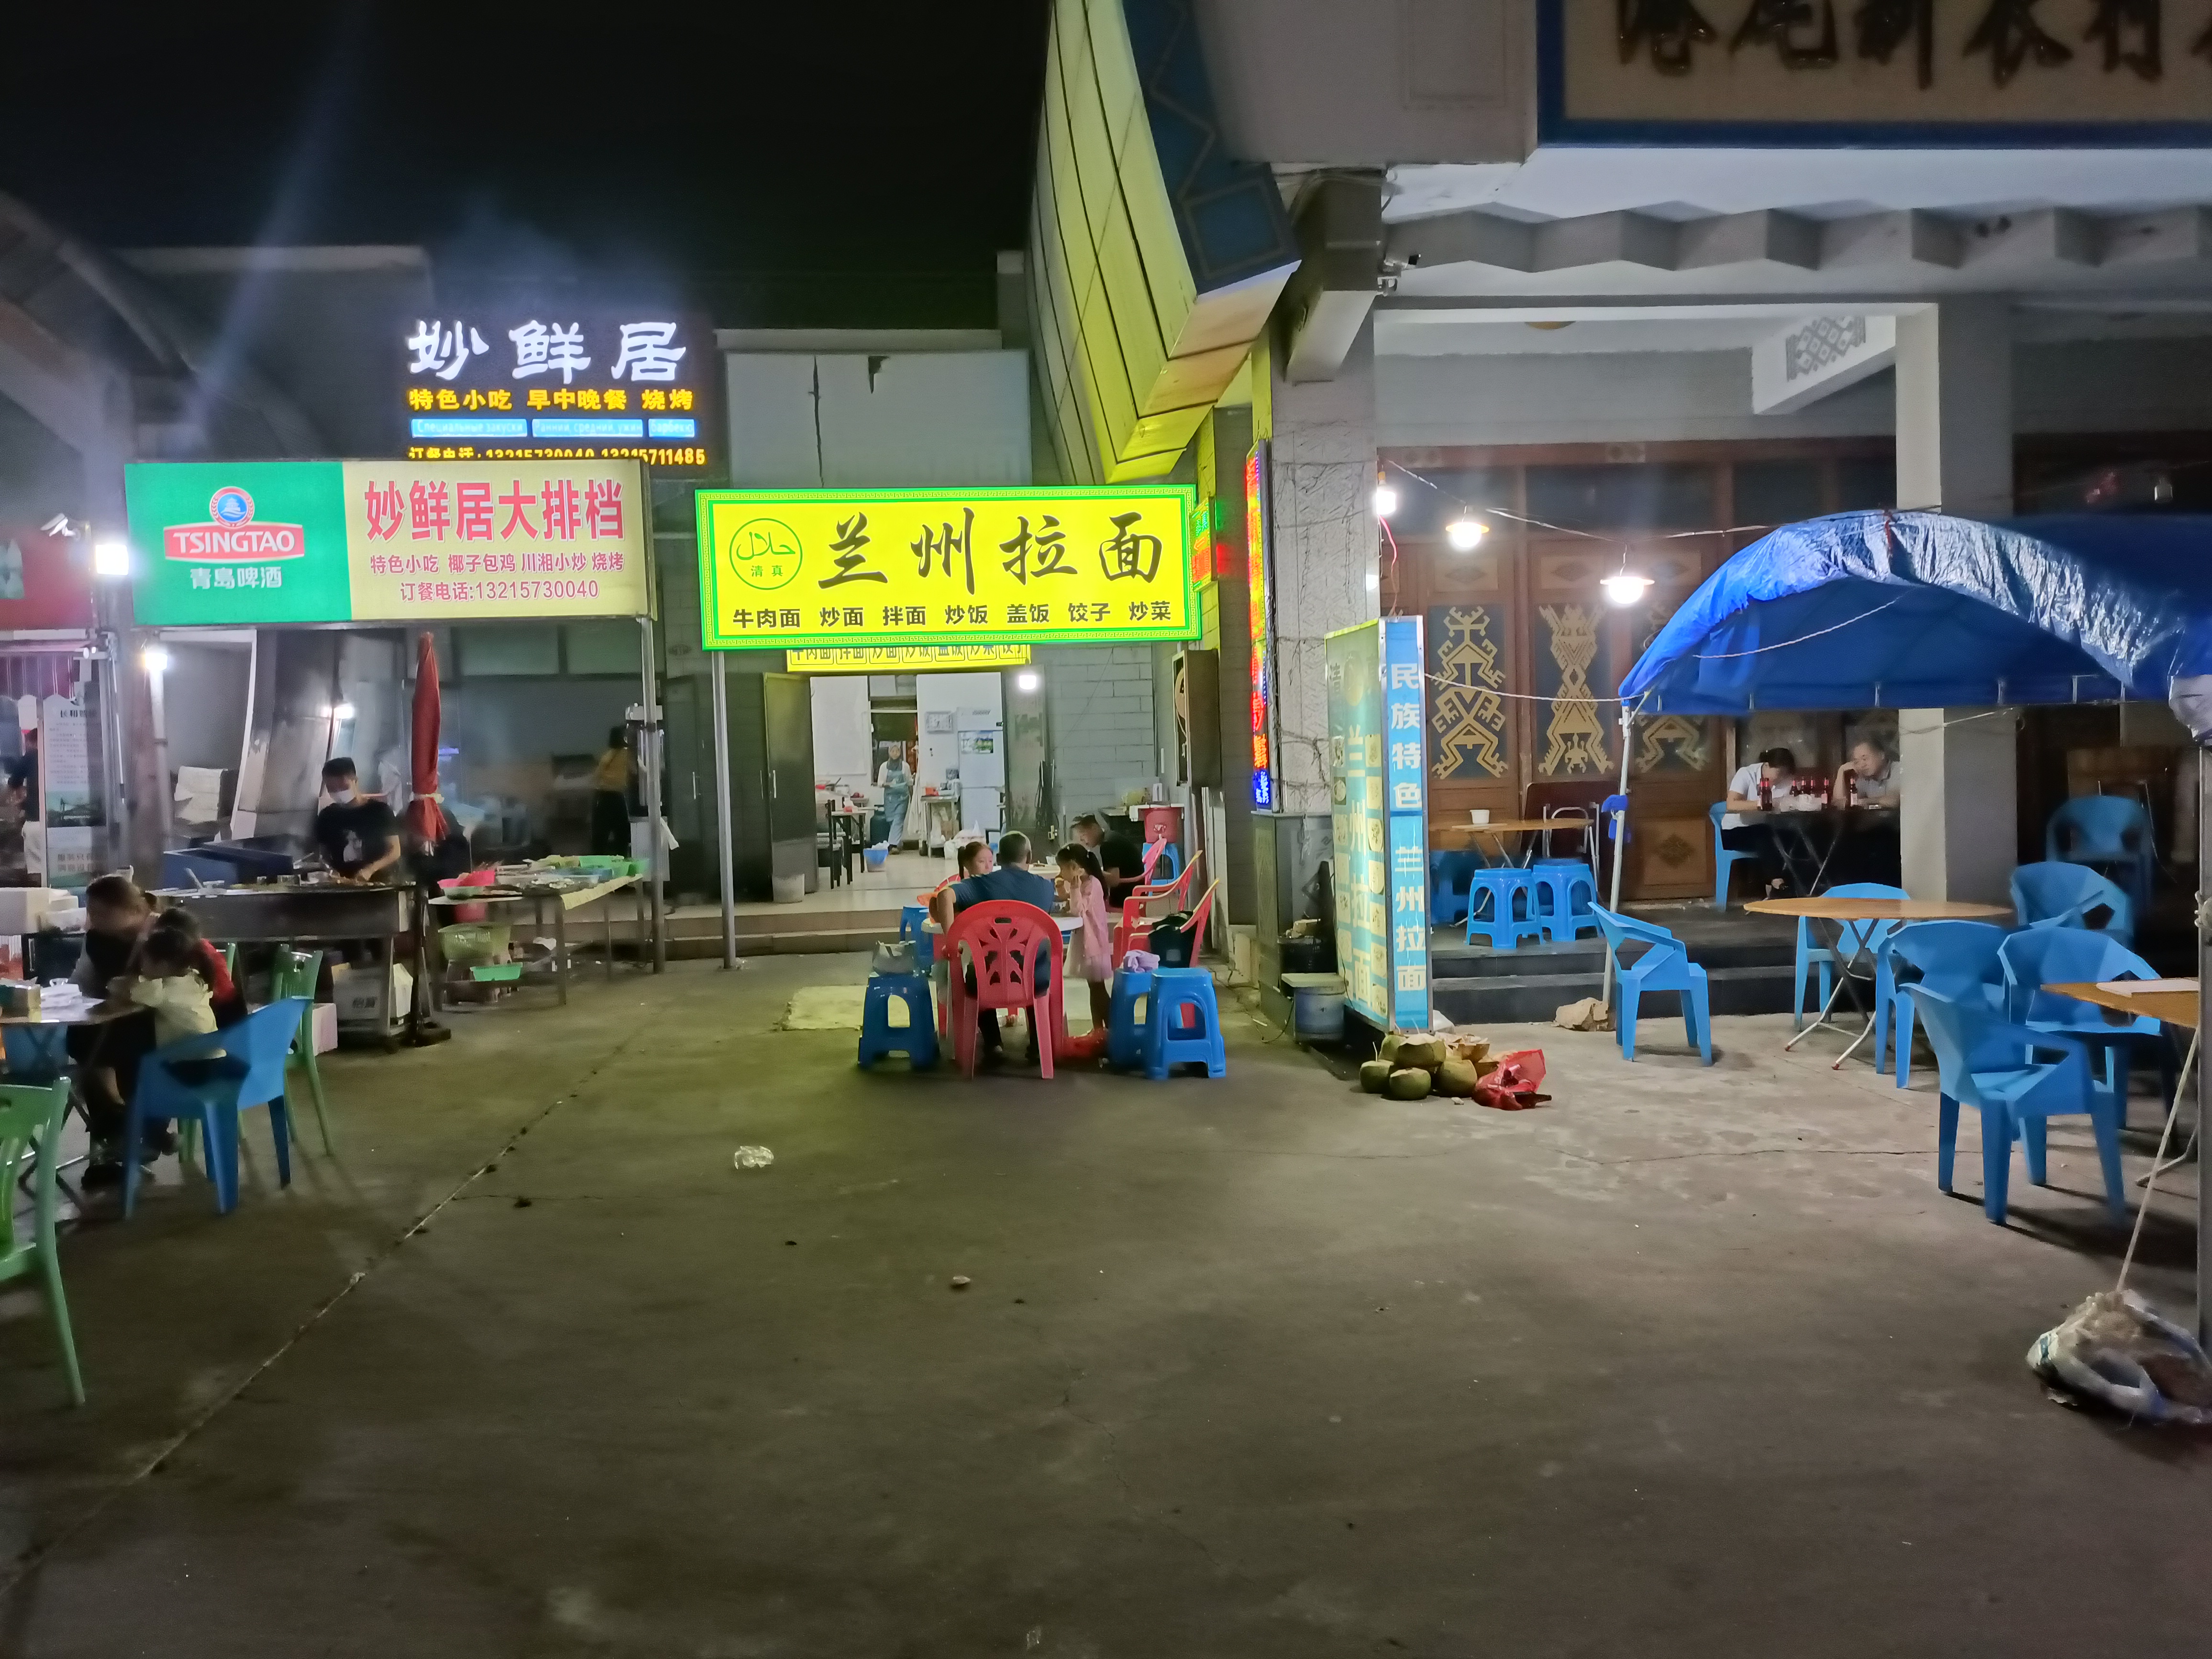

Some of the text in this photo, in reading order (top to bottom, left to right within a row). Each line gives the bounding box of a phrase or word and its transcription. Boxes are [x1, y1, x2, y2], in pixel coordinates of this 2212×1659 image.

[409, 320, 686, 384] 妙鲜居
[409, 389, 693, 410] 特色小吃 早中晚餐 烧烤
[365, 479, 624, 541] 妙鲜居大排档
[173, 531, 295, 553] TSINGTAO
[370, 551, 624, 574] 特色小吃 椰子包鸡 川湘小炒 烧烤
[736, 531, 796, 561] حلال
[818, 507, 1162, 595] 兰州拉面
[751, 565, 783, 577] 清真
[733, 601, 1171, 629] 牛肉面 炒面 拌面 炒饭 盖饭 饺子 炒菜
[1391, 663, 1422, 808] 民族特色
[1347, 724, 1371, 1007] 兰州拉面
[1394, 846, 1426, 991] 兰州拉面
